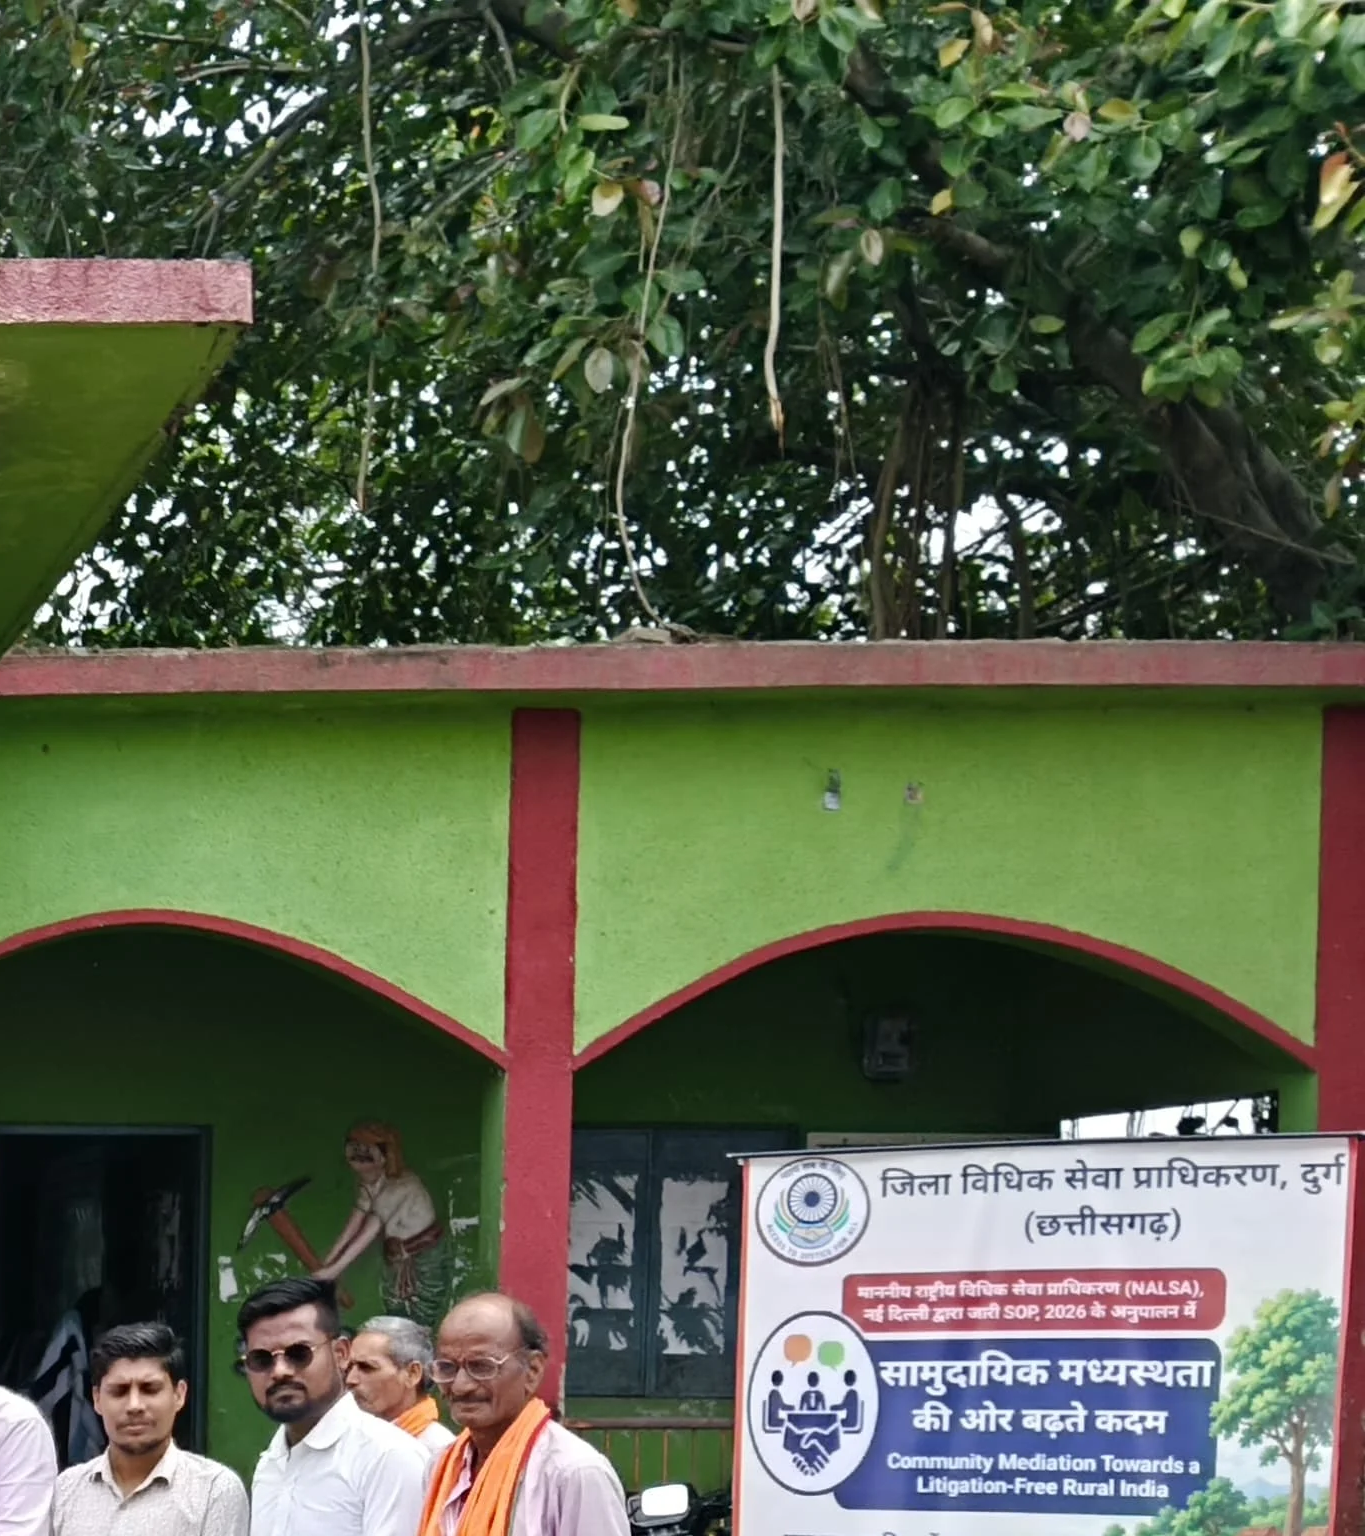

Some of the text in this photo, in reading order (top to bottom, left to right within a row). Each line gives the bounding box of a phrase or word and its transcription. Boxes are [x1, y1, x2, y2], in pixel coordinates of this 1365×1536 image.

[881, 1168, 952, 1197] जिला
[961, 1163, 1055, 1194] विधिक
[1065, 1160, 1124, 1189] सेवा
[1133, 1158, 1287, 1190] प्राधिकरण,
[1301, 1154, 1345, 1194] दुर्ग
[1025, 1205, 1181, 1243] (छत्तीसगढ़)
[879, 1350, 1215, 1396] सामुदायिक मध्यस्थता
[911, 1400, 1168, 1438] की ओर बढ़ते कदम
[887, 1452, 1200, 1474] Community Mediation Towards a
[917, 1476, 1169, 1498] Litigation-Free Rural India
